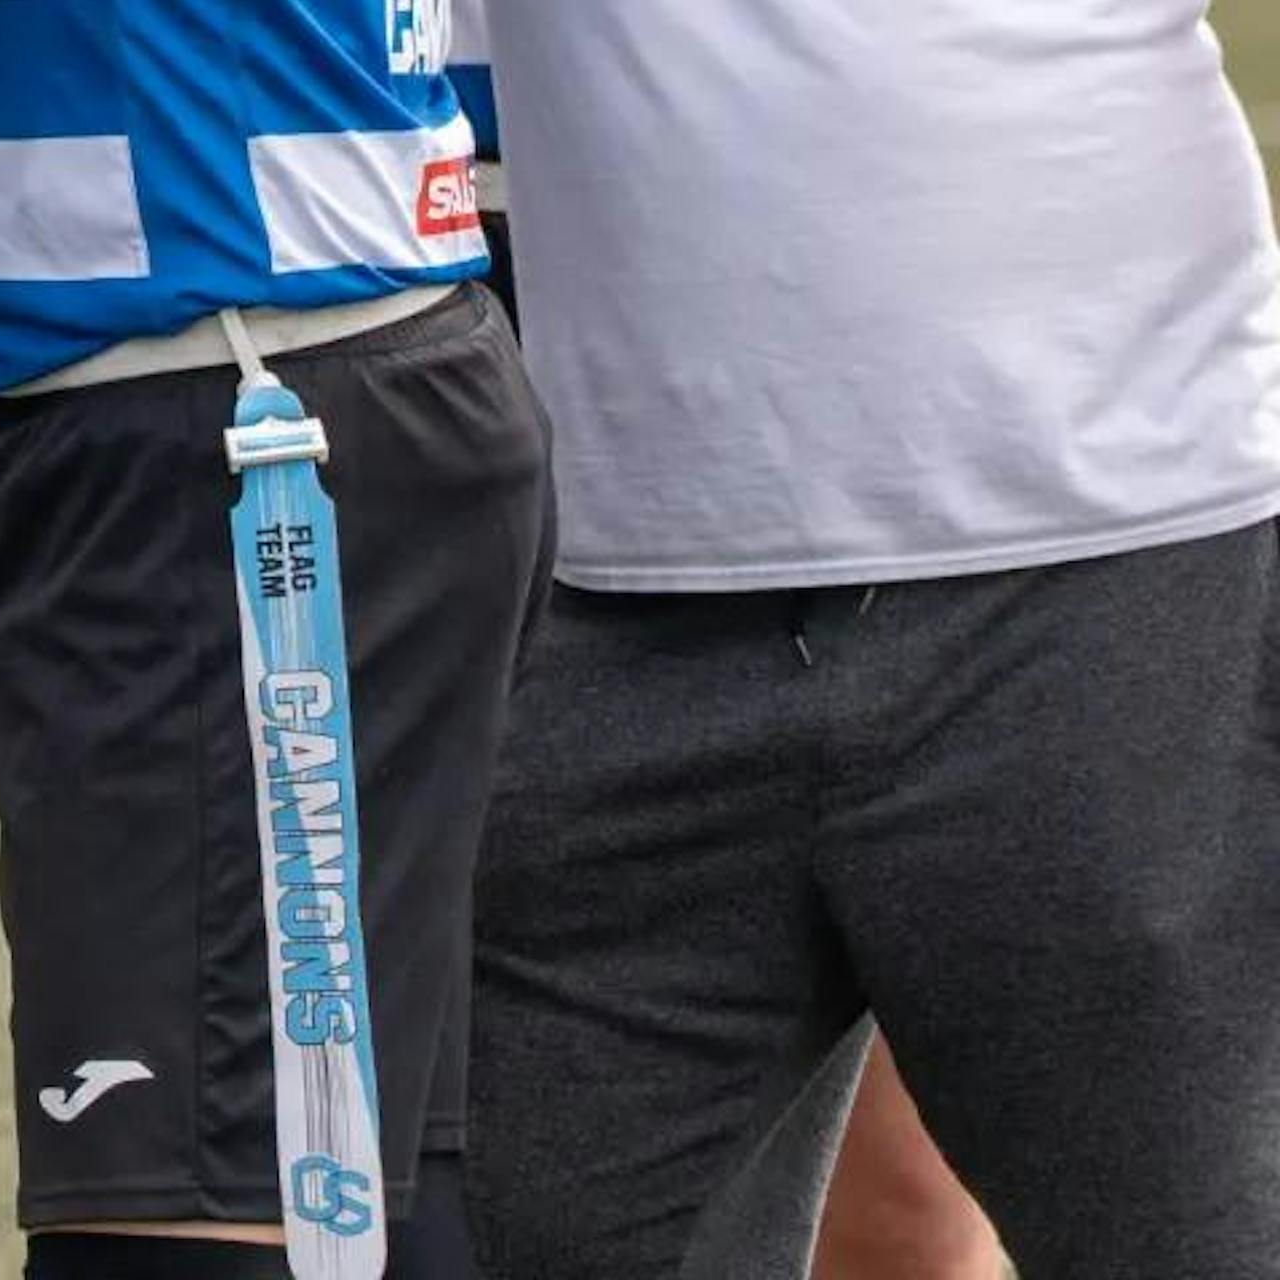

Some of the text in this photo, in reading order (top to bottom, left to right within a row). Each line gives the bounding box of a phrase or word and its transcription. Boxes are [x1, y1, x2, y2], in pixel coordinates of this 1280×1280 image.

[254, 524, 287, 599] TEAM
[286, 523, 317, 592] FLAG
[258, 669, 357, 1047] CANNONS
